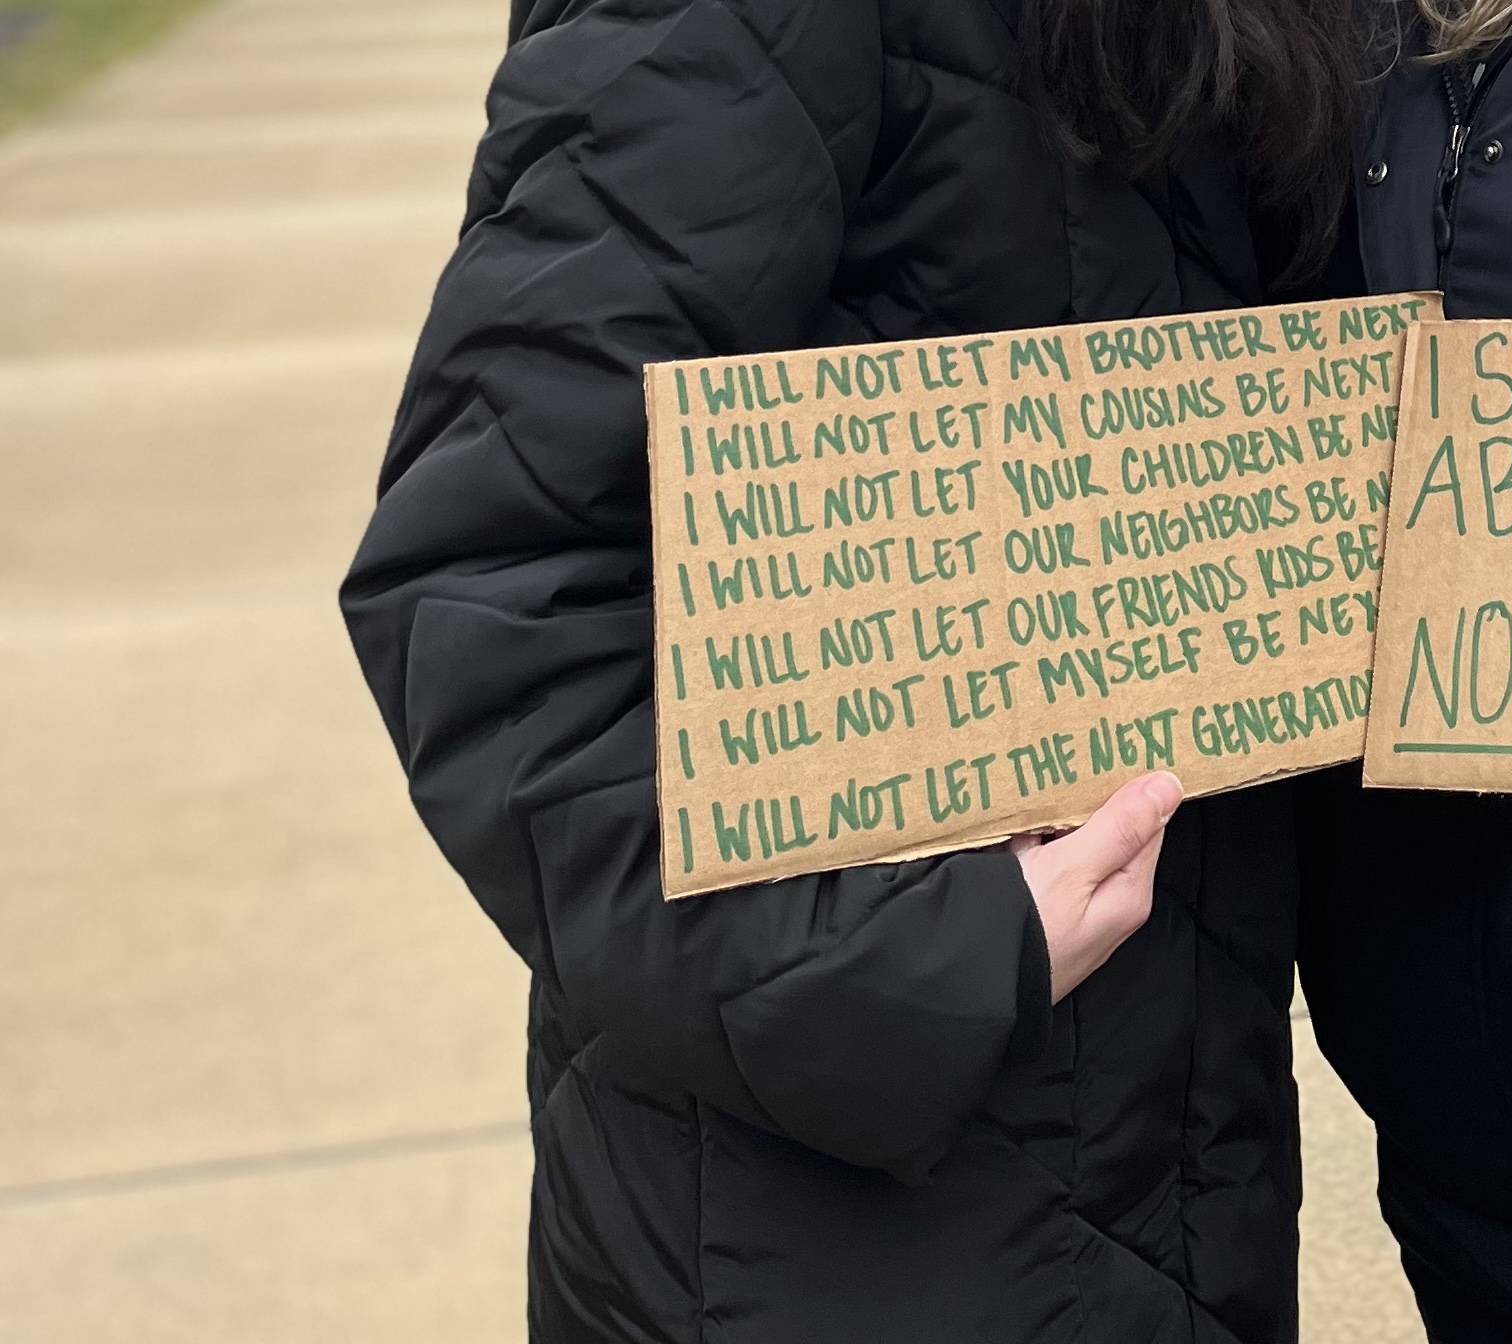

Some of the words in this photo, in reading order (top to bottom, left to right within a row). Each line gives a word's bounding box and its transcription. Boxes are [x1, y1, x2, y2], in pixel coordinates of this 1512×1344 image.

[674, 369, 690, 415] I
[700, 361, 803, 416] WILL
[815, 350, 904, 399] NOT
[917, 339, 994, 390] LET
[1010, 336, 1072, 385] MY
[1086, 315, 1275, 375] BROTHER
[1279, 311, 1328, 352] BE
[1339, 299, 1427, 345] NEXT
[681, 427, 695, 476] I
[707, 422, 801, 476] WILL
[814, 411, 896, 458] NOT
[910, 402, 987, 454] LET
[1002, 393, 1067, 450] MY
[1080, 378, 1226, 441] COUSINS
[1235, 368, 1291, 418] BE
[1303, 351, 1394, 408] NEXT
[1429, 334, 1440, 419] I
[684, 490, 699, 546] I
[715, 482, 812, 546] WILL
[823, 469, 902, 529] NOT
[910, 460, 983, 518] LET
[1001, 452, 1108, 516] YOUR
[1120, 423, 1305, 495] CHILDREN
[1306, 414, 1354, 462] BE
[1361, 403, 1399, 448] NE
[671, 644, 686, 701] I
[705, 631, 810, 690] WILL
[820, 609, 896, 670] NOT
[912, 599, 991, 663] LET
[1007, 590, 1090, 647] OUR
[1092, 566, 1248, 639] FRIENDS
[1255, 534, 1336, 599] KIDS
[1336, 524, 1384, 582] BE
[676, 564, 696, 616] I
[708, 554, 812, 610] WILL
[822, 540, 896, 591] NOT
[905, 532, 984, 585] LET
[1004, 521, 1092, 576] OUR
[1099, 484, 1302, 568] NEIGHBORS
[1304, 476, 1356, 525] BE
[678, 728, 694, 780] I
[717, 702, 822, 765] WILL
[834, 675, 926, 744] NOT
[943, 662, 1020, 730] LET
[1037, 627, 1202, 706] MYSELF
[1222, 610, 1285, 666] BE
[1298, 586, 1382, 646] NEX
[676, 807, 694, 875] I
[711, 794, 820, 863] WILL
[827, 772, 911, 841] NOT
[924, 754, 996, 823] LET
[1007, 733, 1079, 799] THE
[1087, 707, 1180, 773] NEXT
[1190, 669, 1374, 759] GENERATIO
